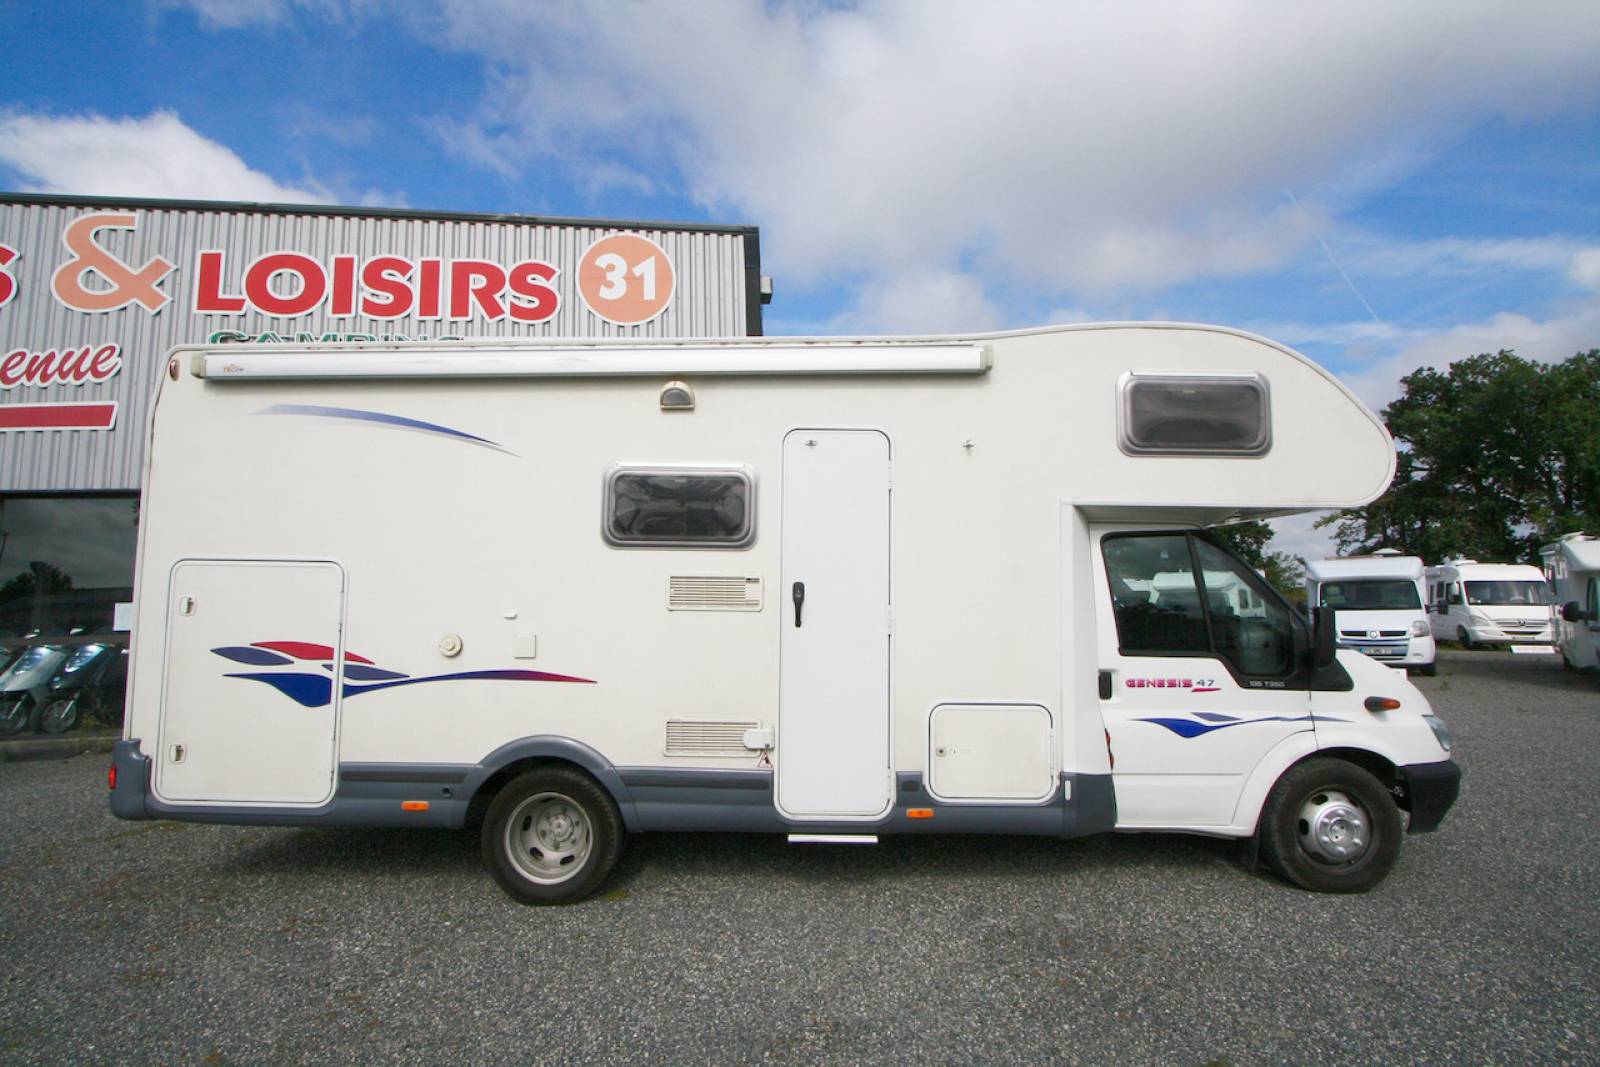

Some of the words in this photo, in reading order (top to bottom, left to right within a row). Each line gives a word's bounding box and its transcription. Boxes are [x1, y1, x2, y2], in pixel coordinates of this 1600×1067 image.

[52, 211, 177, 313] &
[194, 251, 560, 324] LOISIRS
[594, 253, 656, 301] 31
[1126, 679, 1193, 688] GENESIS
[1196, 679, 1215, 687] 47
